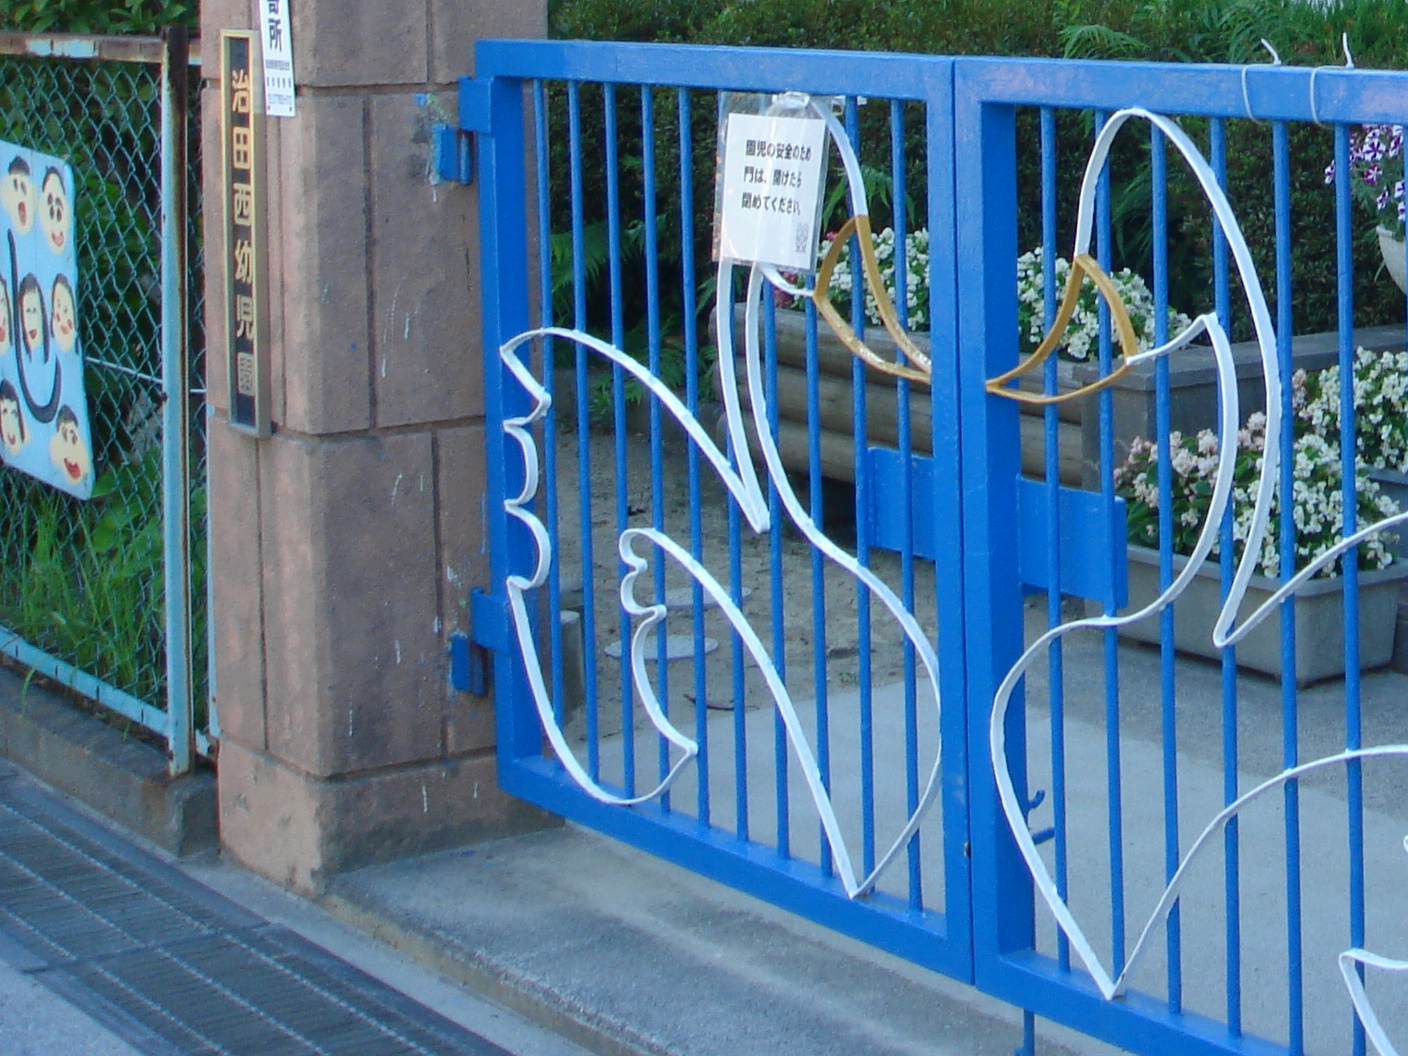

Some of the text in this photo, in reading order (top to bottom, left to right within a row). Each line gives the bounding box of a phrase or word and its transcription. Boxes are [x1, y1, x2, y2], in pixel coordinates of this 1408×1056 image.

[231, 68, 255, 396] 治田西幼児園
[746, 139, 812, 161] 園児の安全のため
